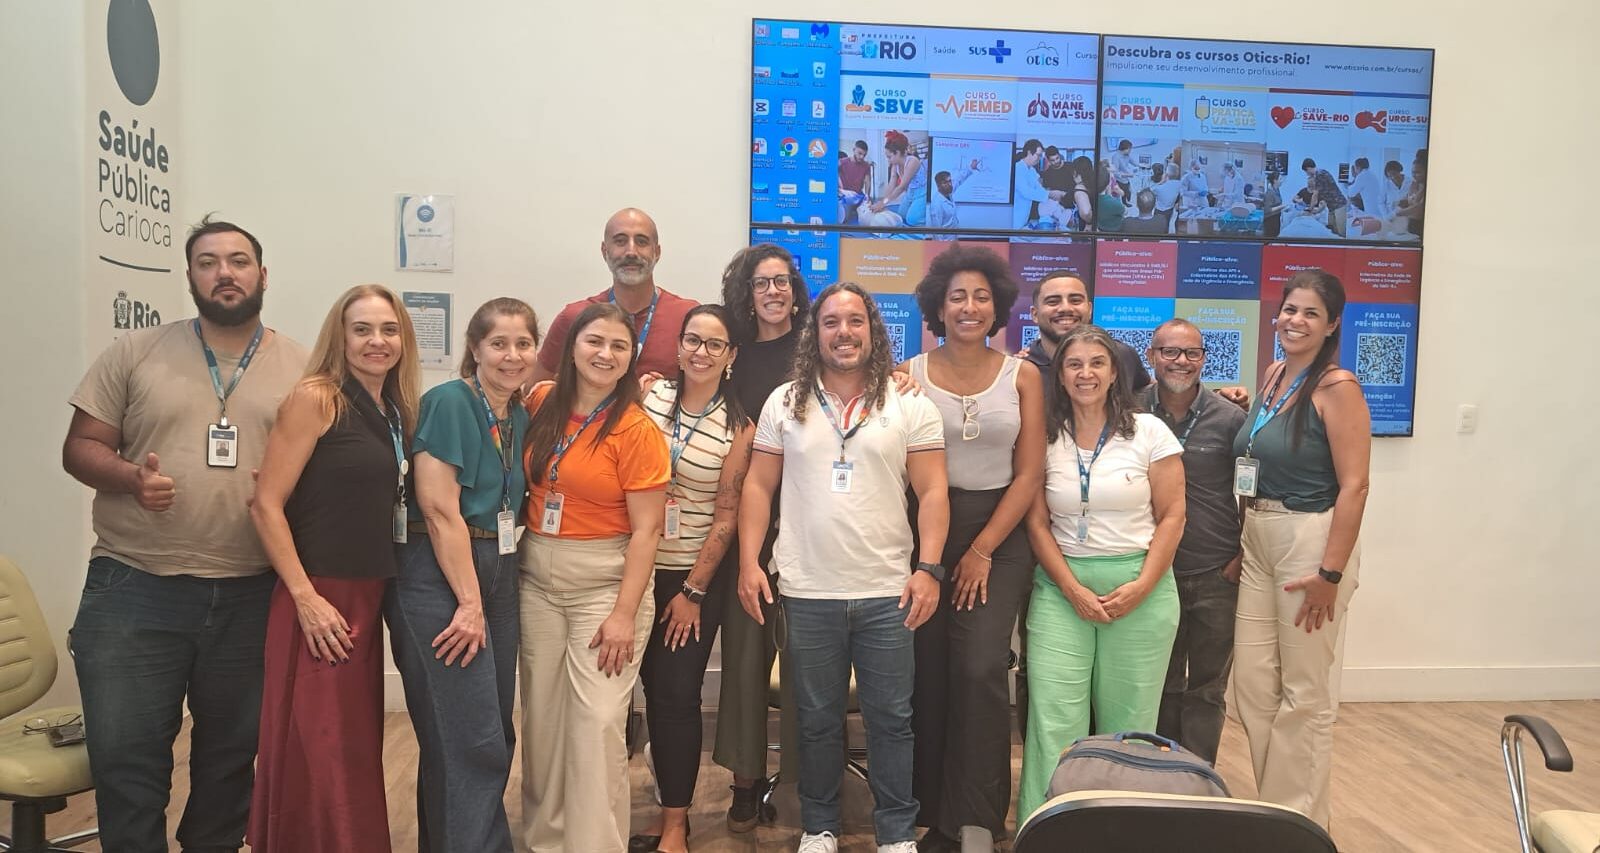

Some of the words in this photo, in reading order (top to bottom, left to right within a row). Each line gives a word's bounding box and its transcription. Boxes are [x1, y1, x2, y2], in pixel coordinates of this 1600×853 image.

[880, 41, 916, 60] RIO
[933, 46, 957, 54] Saúde
[968, 46, 987, 56] SUS
[1107, 45, 1172, 59] Descubra
[1176, 50, 1191, 60] os
[1195, 52, 1239, 62] cursos
[1243, 51, 1310, 65] Otics-Rio!
[1026, 54, 1060, 66] otics
[1107, 61, 1154, 70] Impulsione
[1173, 63, 1246, 75] desenvolvimento
[1247, 67, 1295, 77] profissional
[874, 89, 907, 97] CURSO
[965, 91, 997, 100] CURSO
[1052, 93, 1083, 101] CURSO
[874, 98, 924, 115] SBVE
[1052, 101, 1084, 110] MANE
[1212, 99, 1246, 108] CURSO
[1052, 110, 1095, 120] VA-SUS
[1119, 104, 1179, 122] PBVM
[1302, 113, 1350, 122] SAVE-RIO
[1212, 117, 1256, 126] VA-SUS
[1388, 115, 1428, 124] URGE-SU
[99, 110, 169, 173] Saúde
[99, 158, 171, 213] Pública
[99, 199, 172, 248] Carioca
[133, 300, 161, 330] Rio
[1112, 306, 1133, 315] FAÇA
[1199, 307, 1218, 317] FAÇA
[1101, 314, 1162, 324] PRÉ-INSCRIÇÃO
[1365, 312, 1385, 320] FAÇA
[1354, 320, 1412, 330] PRÉ-INSCRIÇÃO
